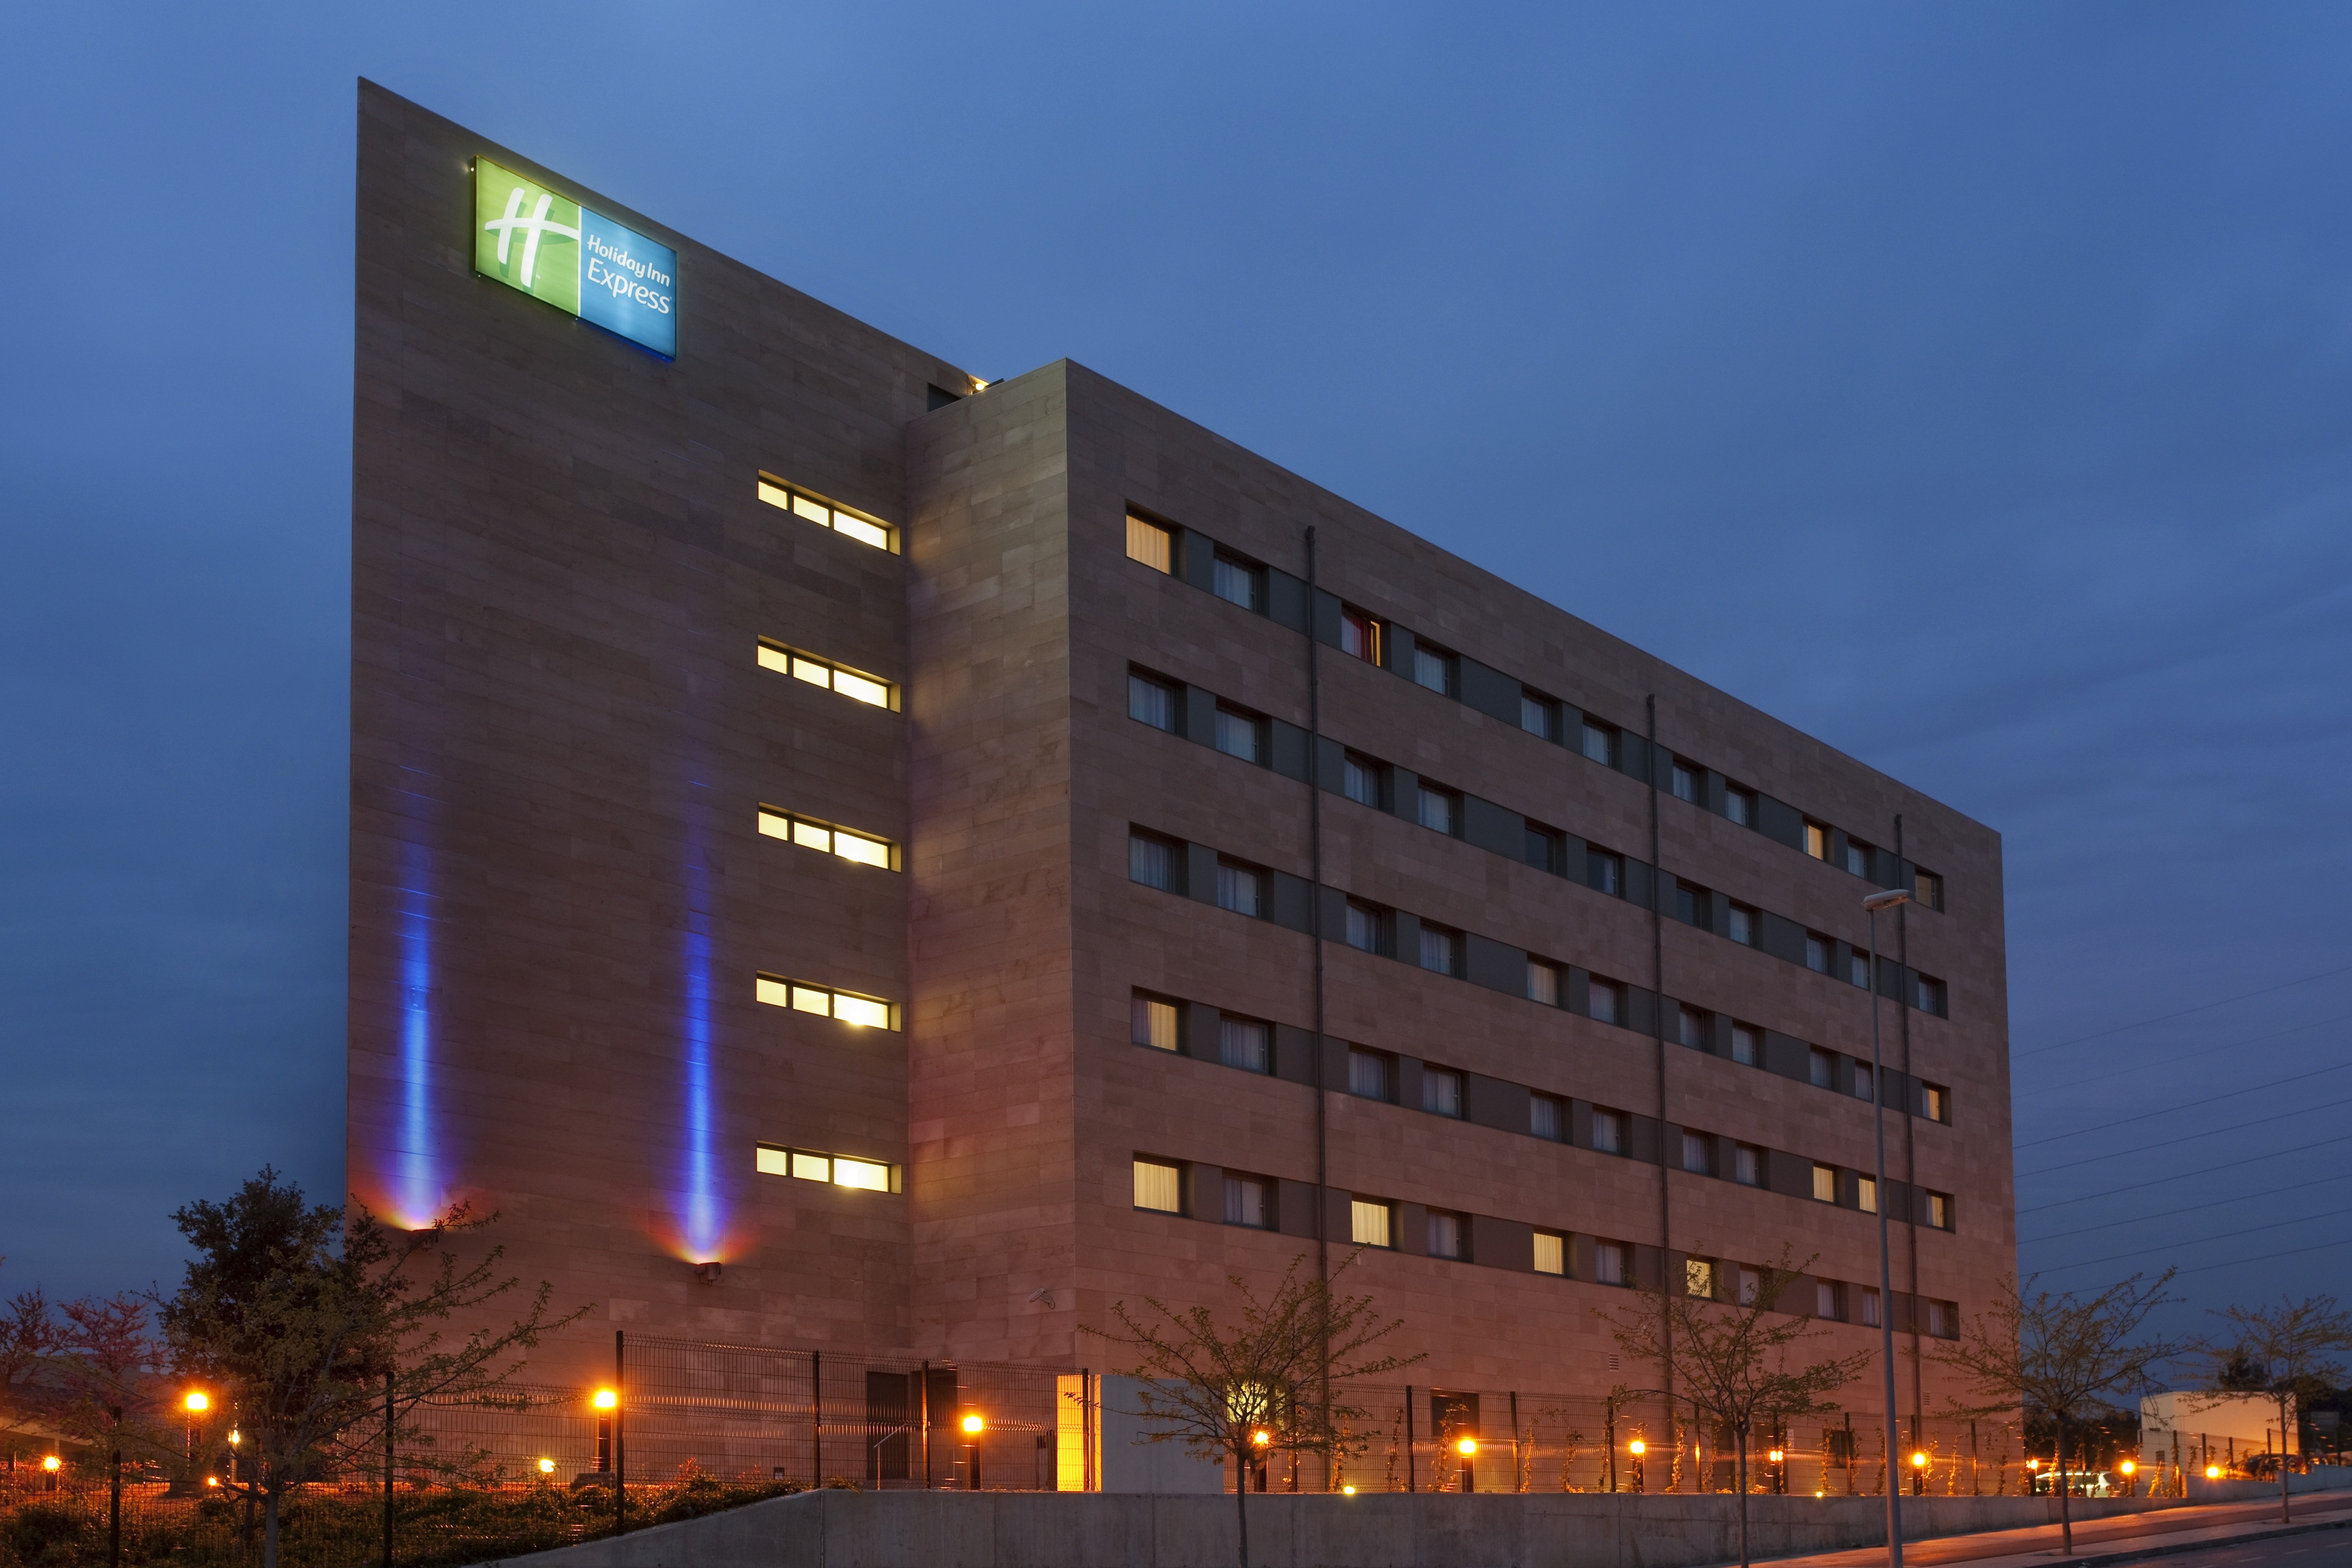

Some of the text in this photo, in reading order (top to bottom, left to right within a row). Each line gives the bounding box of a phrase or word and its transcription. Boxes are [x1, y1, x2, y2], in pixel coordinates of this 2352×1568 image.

[587, 234, 670, 287] Holiday Inn
[588, 257, 669, 314] Express
